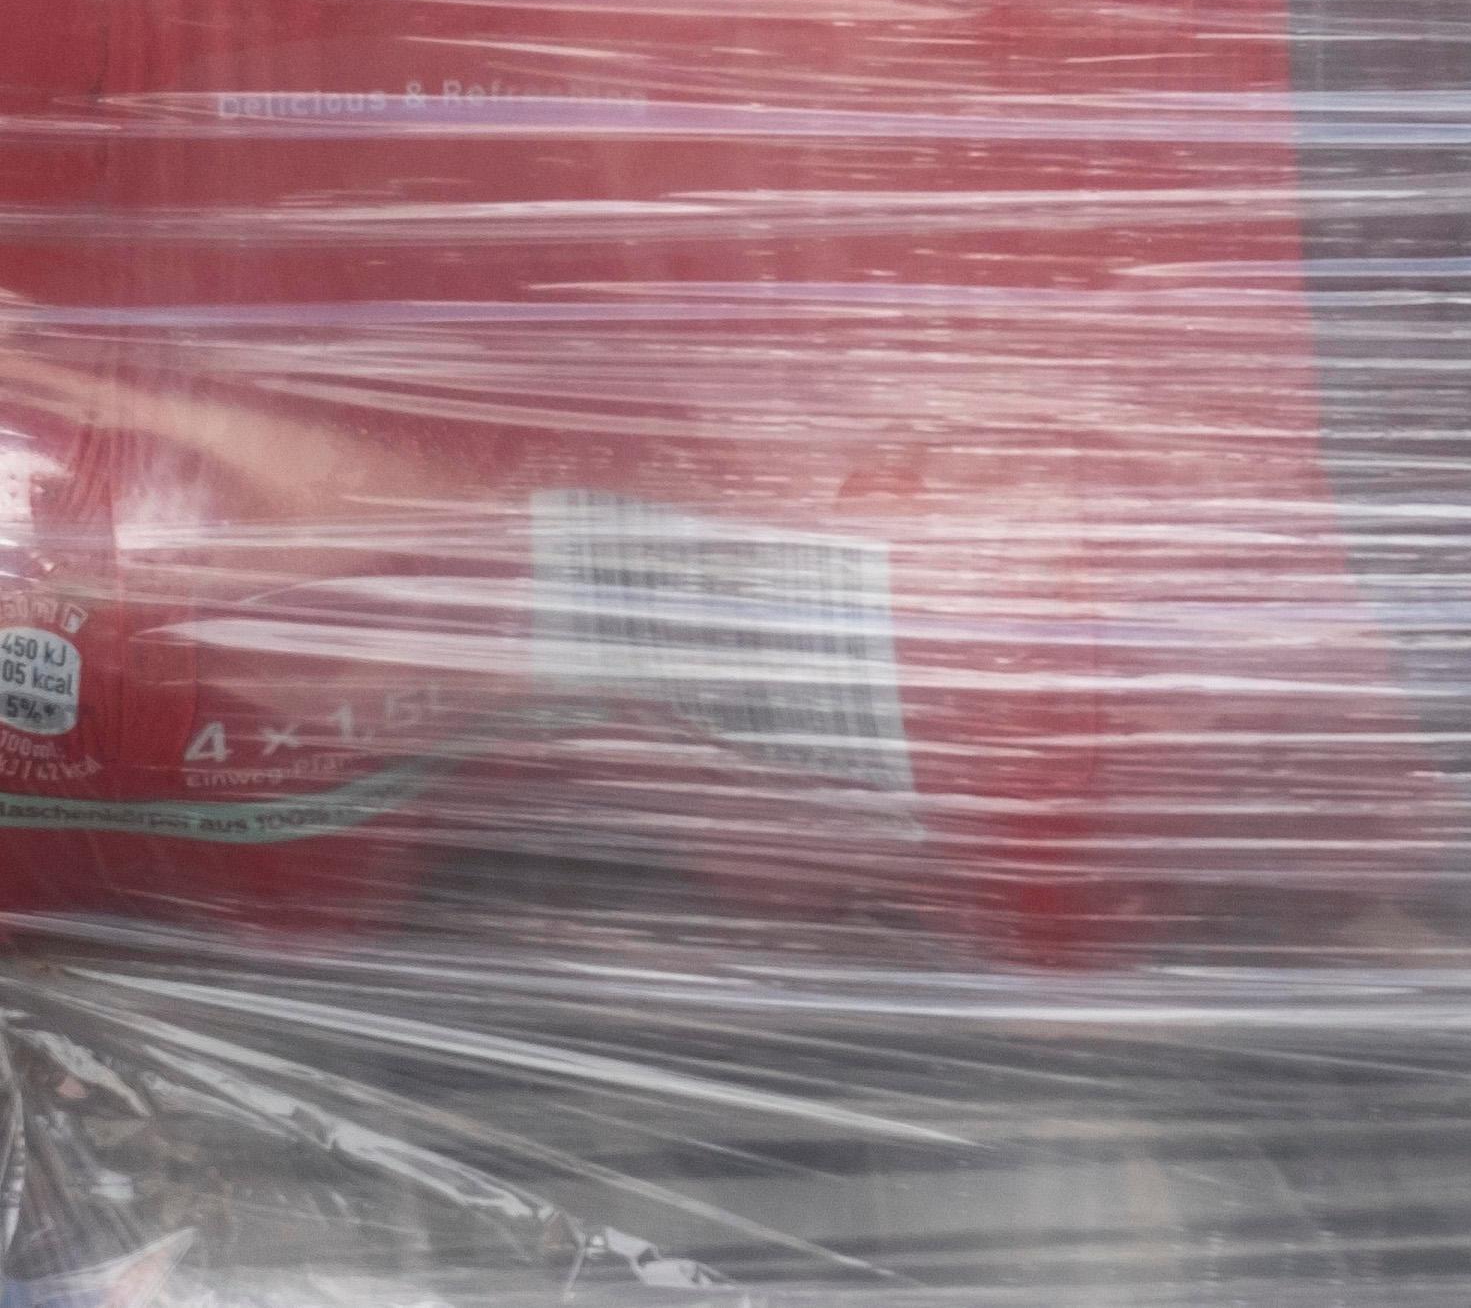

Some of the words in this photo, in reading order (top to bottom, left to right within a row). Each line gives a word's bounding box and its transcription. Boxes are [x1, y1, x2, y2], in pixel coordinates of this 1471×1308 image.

[216, 86, 387, 119] Delicious
[404, 79, 429, 111] &
[31, 666, 74, 697] kcal
[184, 721, 233, 763] 4
